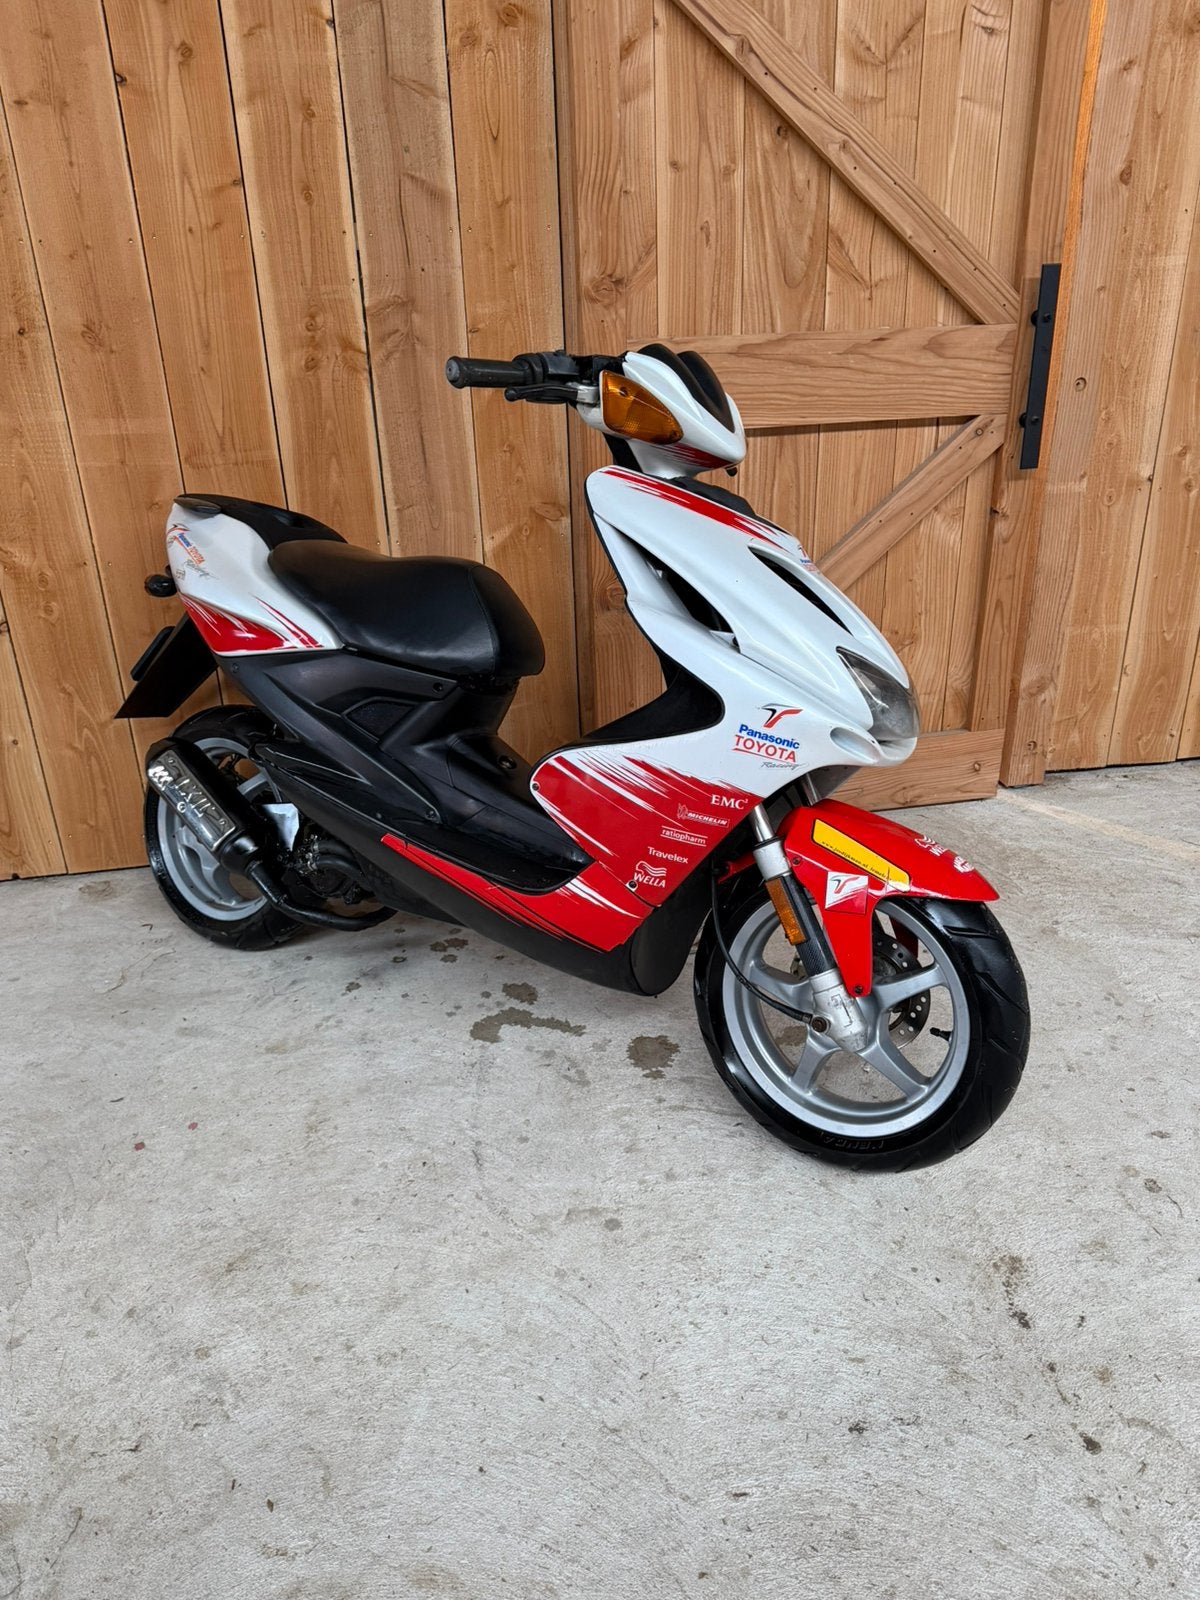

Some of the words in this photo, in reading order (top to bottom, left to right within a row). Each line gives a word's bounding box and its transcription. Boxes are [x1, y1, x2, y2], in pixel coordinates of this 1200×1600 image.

[738, 723, 801, 750] Panasonic
[734, 734, 797, 763] TOYOTA
[759, 761, 804, 771] Racing
[686, 812, 729, 826] MICHELIN
[661, 828, 707, 845] ratiopharm
[647, 846, 689, 864] Travelex
[633, 872, 666, 888] WELLA
